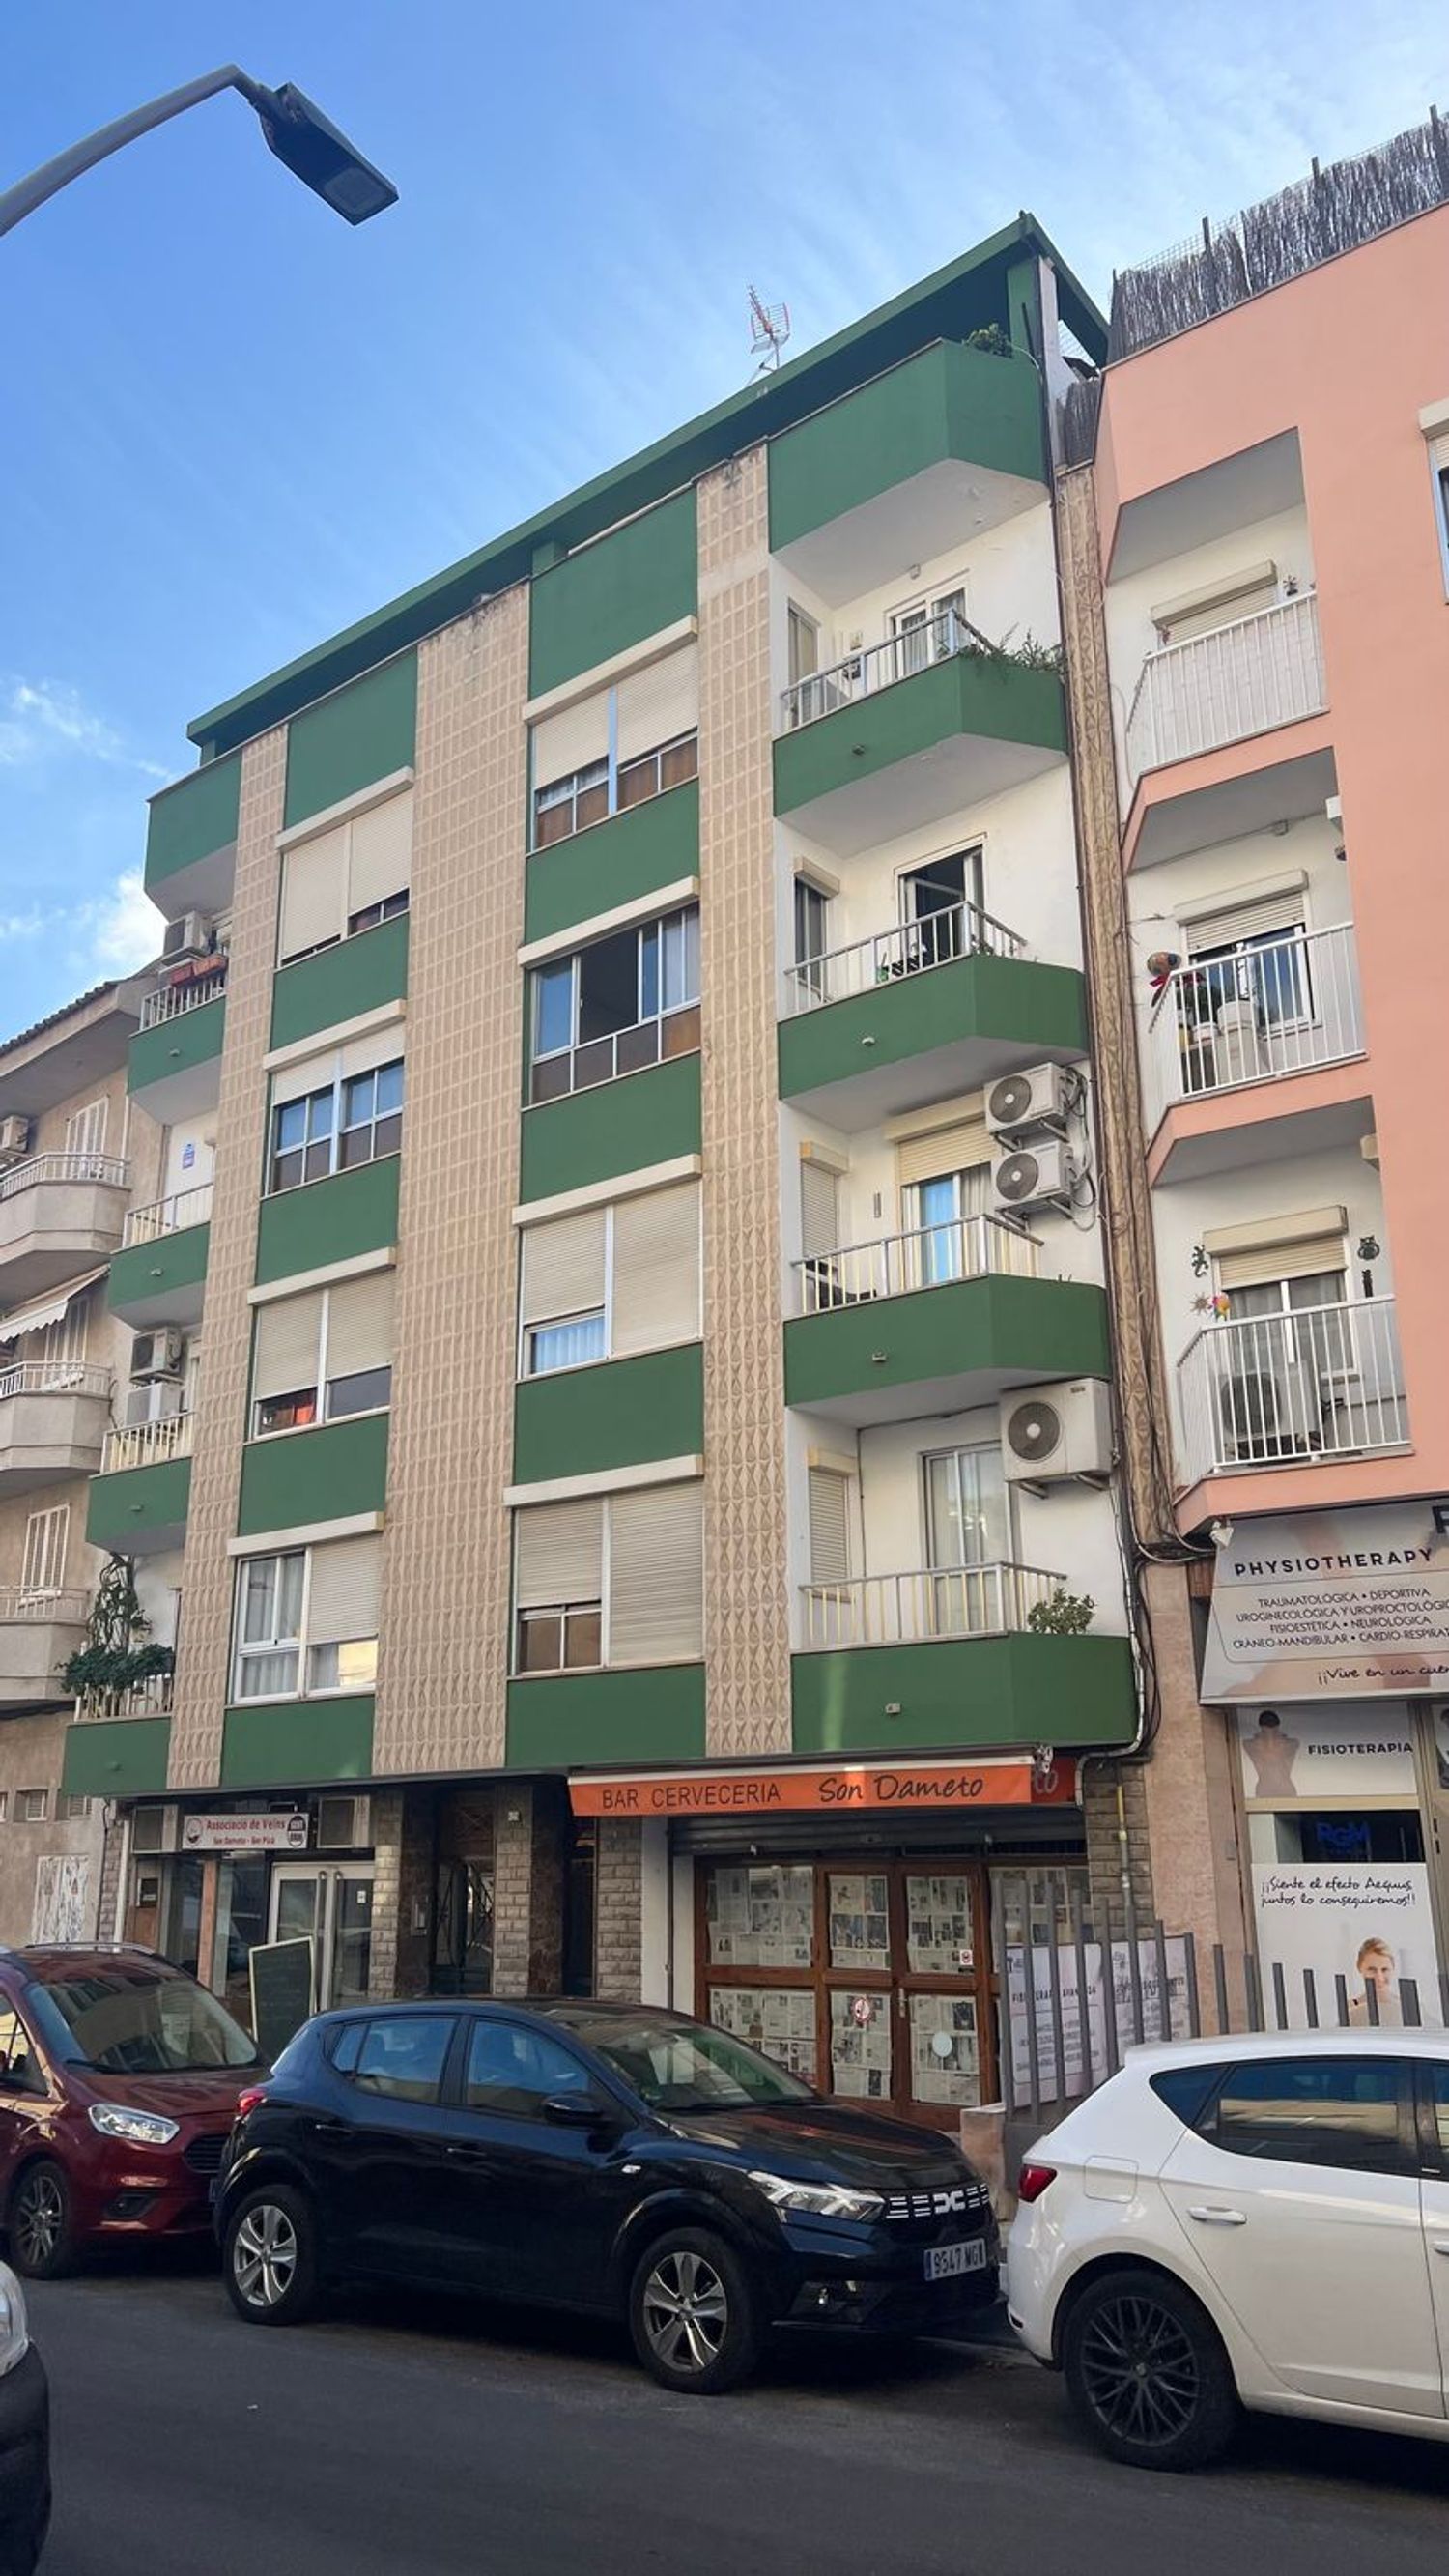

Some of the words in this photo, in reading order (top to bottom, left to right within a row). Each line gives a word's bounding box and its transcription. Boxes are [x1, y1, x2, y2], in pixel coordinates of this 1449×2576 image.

[1235, 1548, 1432, 1576] PHYSIOTHERAPY
[1370, 1589, 1430, 1600] DEPORTIVA
[1340, 1606, 1349, 1616] Y
[1366, 1669, 1385, 1677] en
[1391, 1668, 1415, 1676] un
[1308, 1742, 1413, 1755] FISIOTERAPIA
[602, 1789, 639, 1810] BAR
[651, 1783, 781, 1808] CERVECERIA
[819, 1777, 863, 1802] Son
[874, 1774, 984, 1800] Dameto
[249, 1819, 260, 1830] de
[1309, 1877, 1323, 1889] el
[1325, 1876, 1361, 1892] efecto
[1261, 1892, 1296, 1908] juntos
[1300, 1893, 1315, 1905] lo
[933, 2247, 962, 2274] 9547
